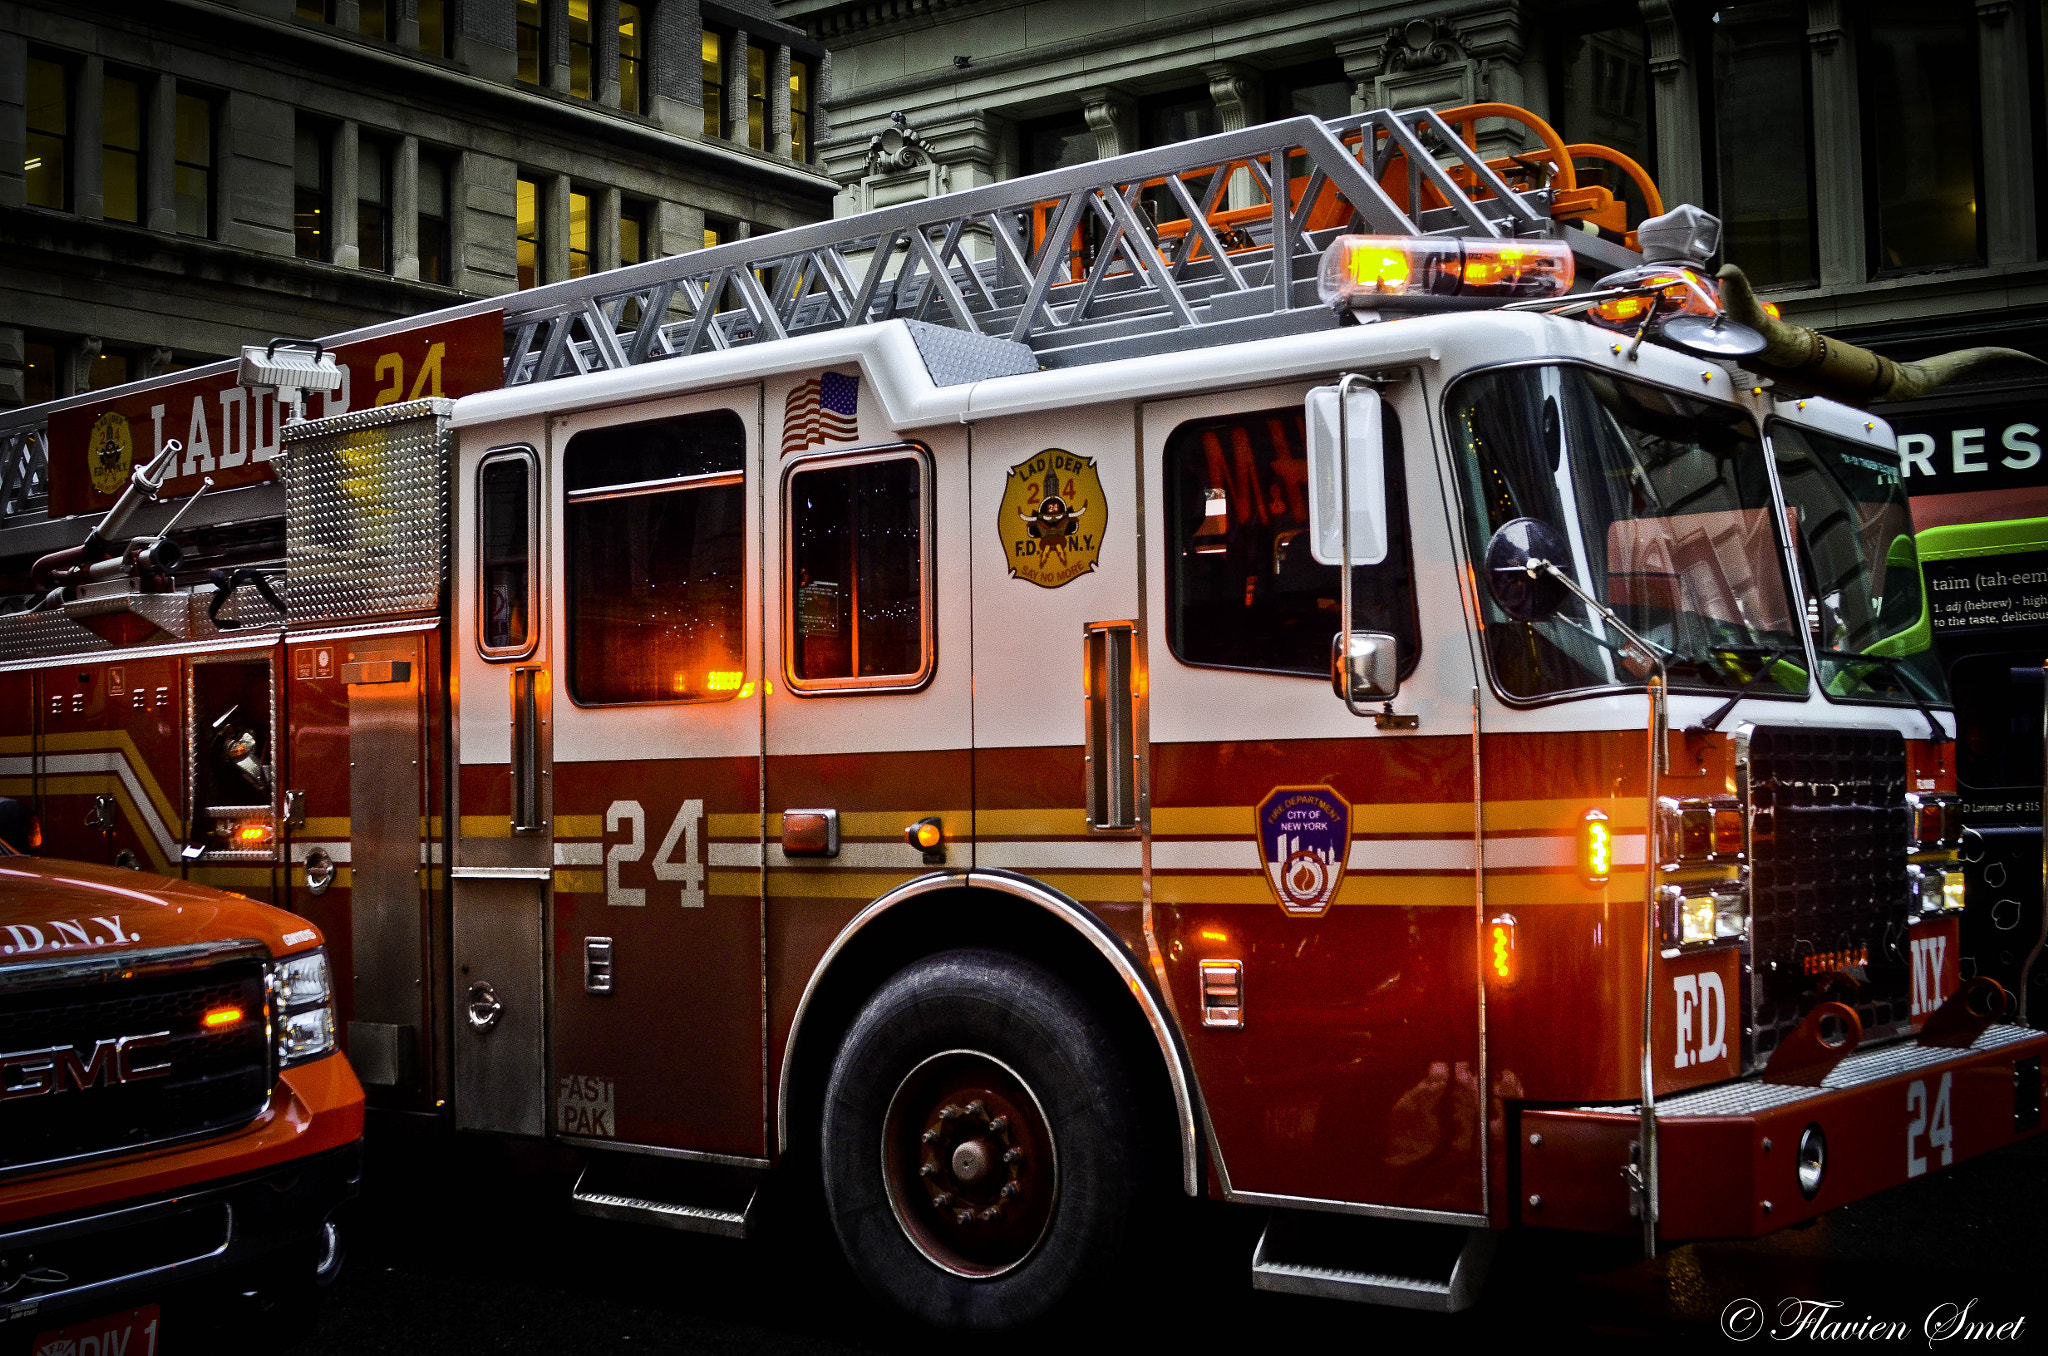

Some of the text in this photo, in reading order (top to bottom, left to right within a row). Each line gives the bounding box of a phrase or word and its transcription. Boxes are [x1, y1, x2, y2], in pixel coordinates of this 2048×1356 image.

[375, 342, 446, 407] 24
[1897, 423, 2042, 478] RES
[1021, 561, 1085, 582] SAY NO MORE
[1945, 601, 1962, 614] adj
[1964, 597, 2012, 613] (hebrew)
[1934, 618, 1946, 628] to
[1948, 616, 1967, 627] the
[1969, 615, 1999, 625] taste,
[1267, 795, 1341, 825] FIRE DEPARTMENT
[1286, 810, 1322, 820] CITY OF
[2024, 801, 2040, 812] 315
[1280, 822, 1328, 831] NEW YORK
[606, 798, 705, 909] 24
[1672, 971, 1729, 1069] F.D.
[0, 1031, 172, 1101] GMC
[557, 1076, 614, 1103] FAST
[564, 1105, 608, 1136] PAK
[1906, 1071, 1954, 1179] 24
